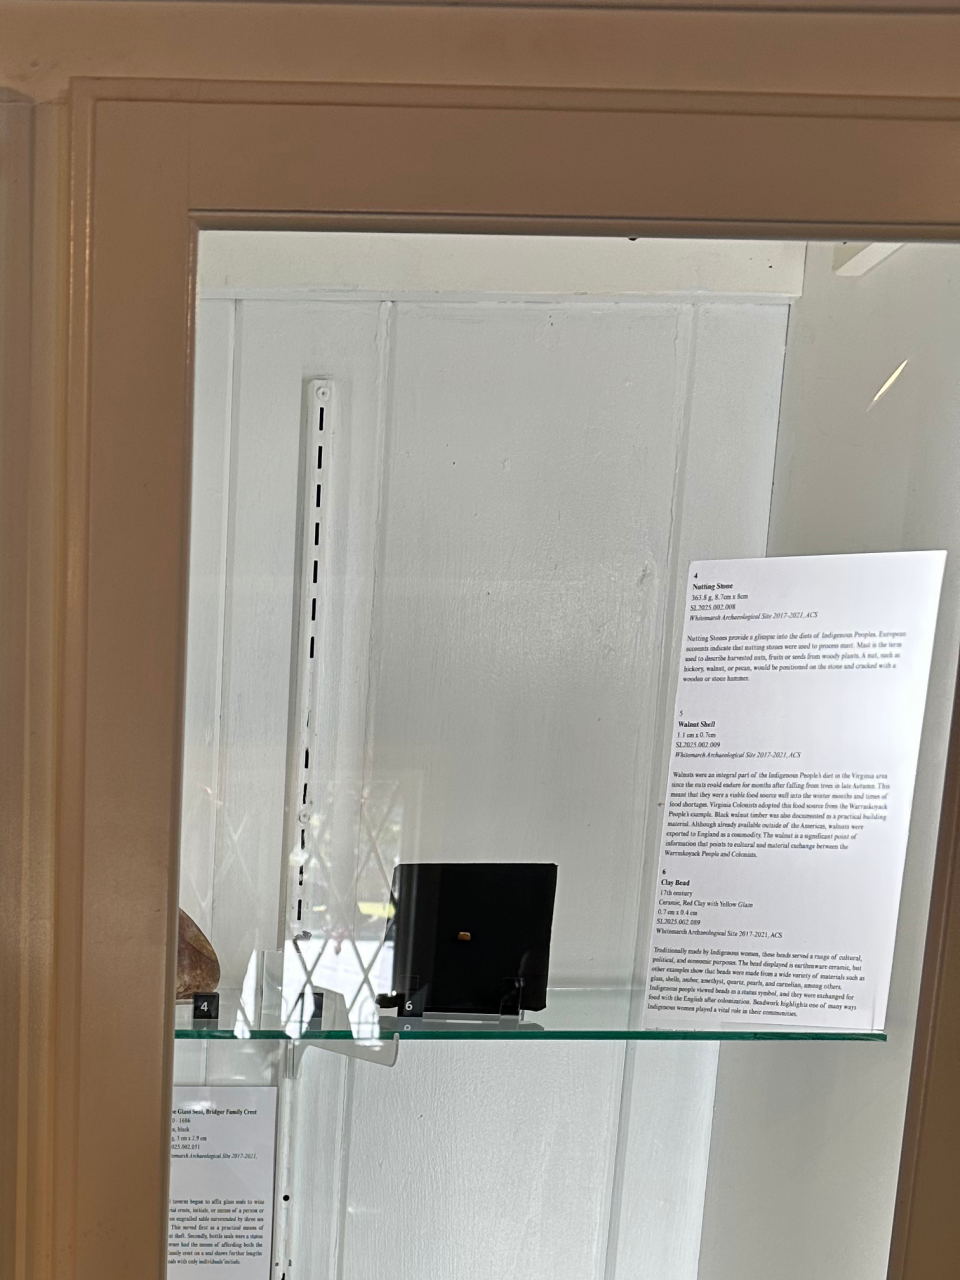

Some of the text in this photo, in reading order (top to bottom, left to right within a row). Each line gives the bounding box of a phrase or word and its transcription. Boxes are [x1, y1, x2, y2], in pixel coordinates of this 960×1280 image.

[692, 583, 715, 591] Nutting
[660, 878, 673, 887] Clay
[693, 899, 706, 908] Clay
[200, 1001, 209, 1012] 4
[405, 1000, 413, 1011] 6
[205, 1108, 225, 1116] Bridger
